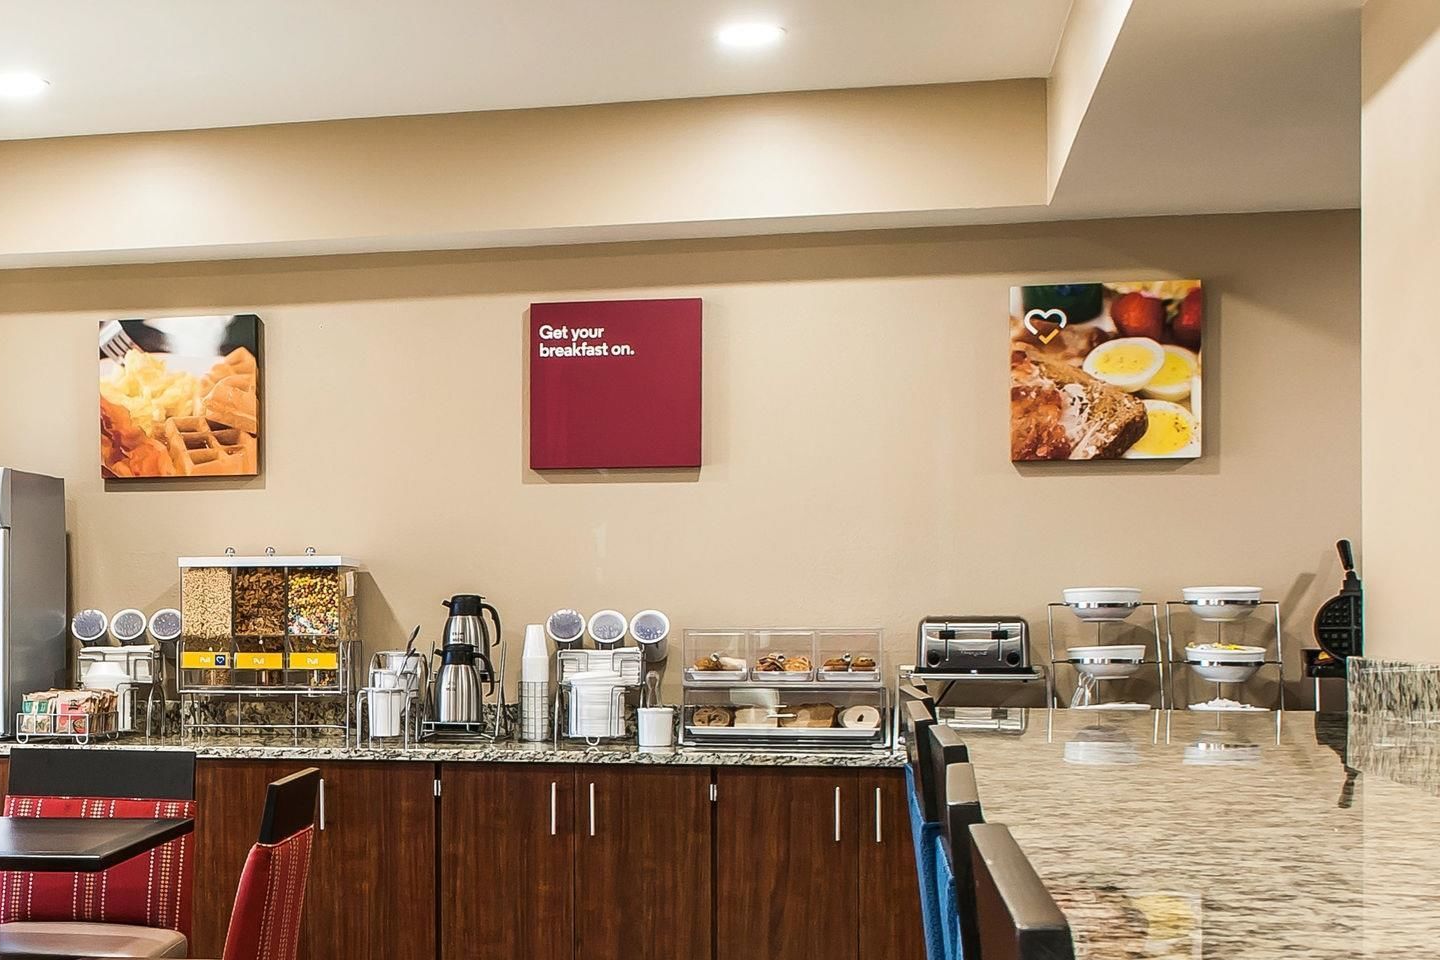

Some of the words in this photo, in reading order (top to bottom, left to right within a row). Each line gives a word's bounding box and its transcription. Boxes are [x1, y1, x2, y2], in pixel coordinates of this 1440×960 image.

[539, 325, 569, 339] Get
[570, 328, 605, 342] your
[539, 342, 609, 357] breakfast
[610, 345, 635, 356] on.
